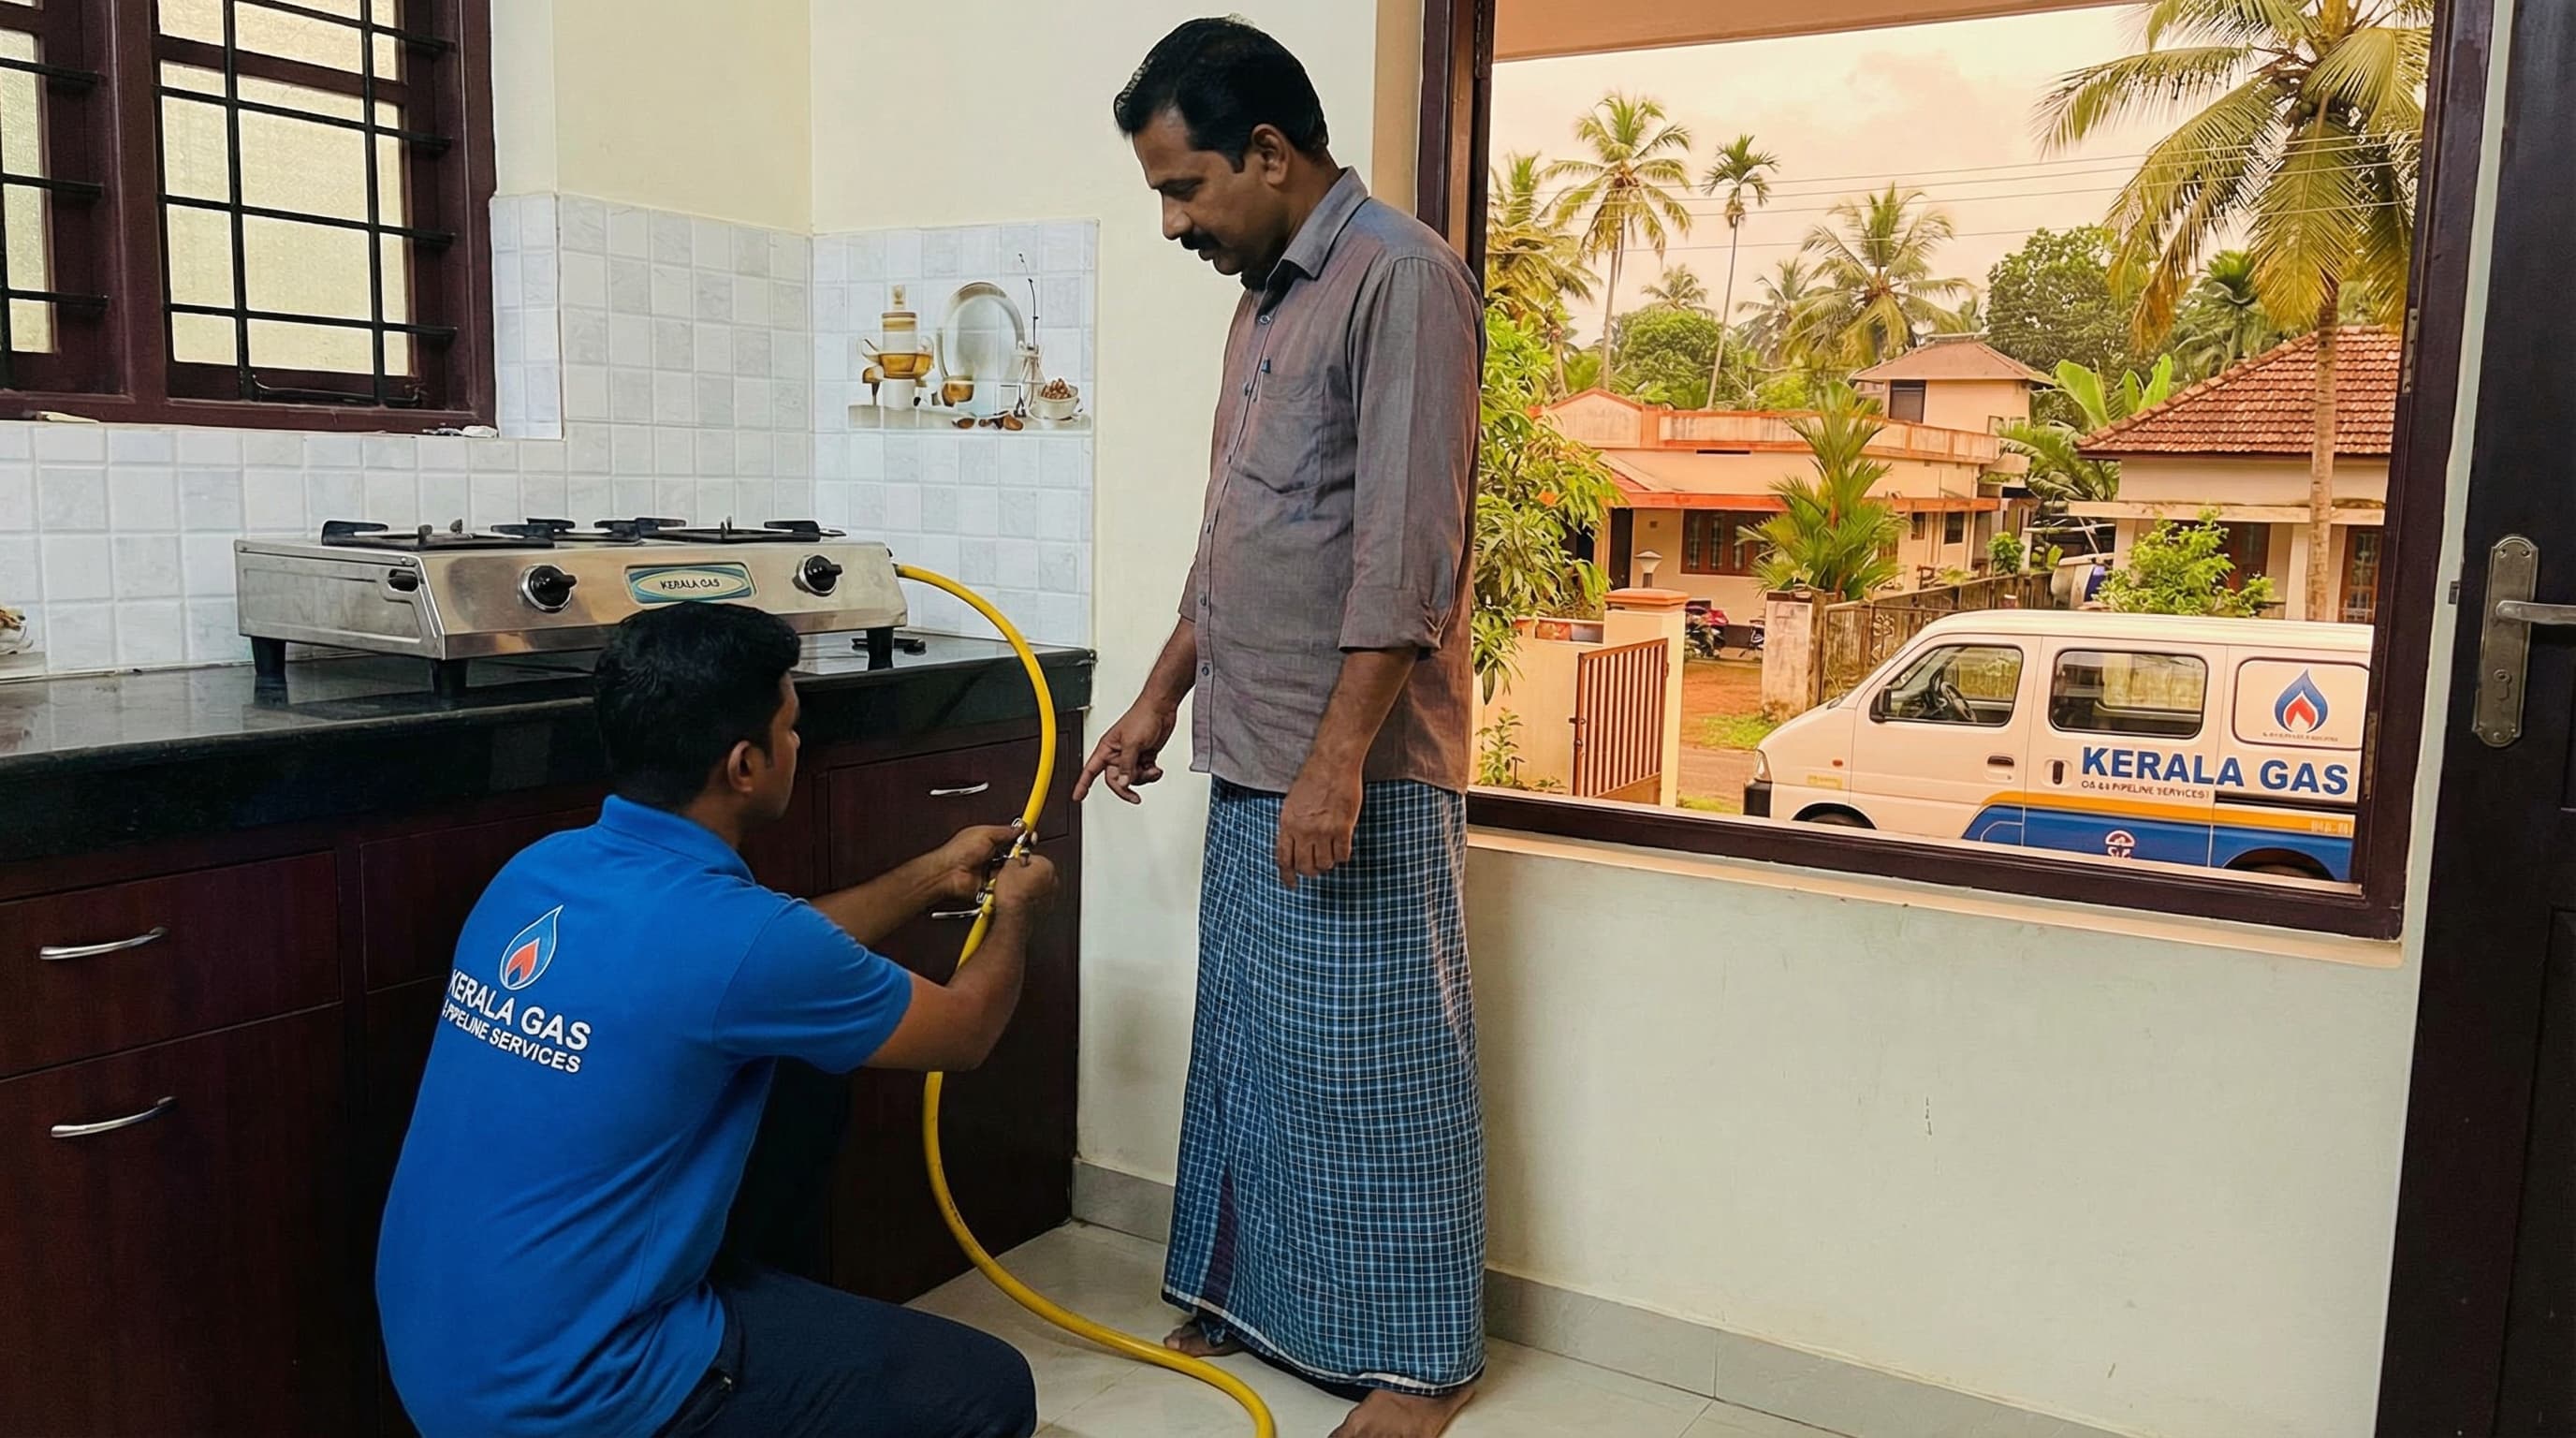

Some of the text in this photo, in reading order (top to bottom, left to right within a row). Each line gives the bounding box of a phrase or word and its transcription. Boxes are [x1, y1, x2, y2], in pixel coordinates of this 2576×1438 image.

[2082, 746, 2349, 795] KERALA GAS
[447, 968, 592, 1050] KERALA GAS
[489, 1027, 581, 1073] SERVICES
